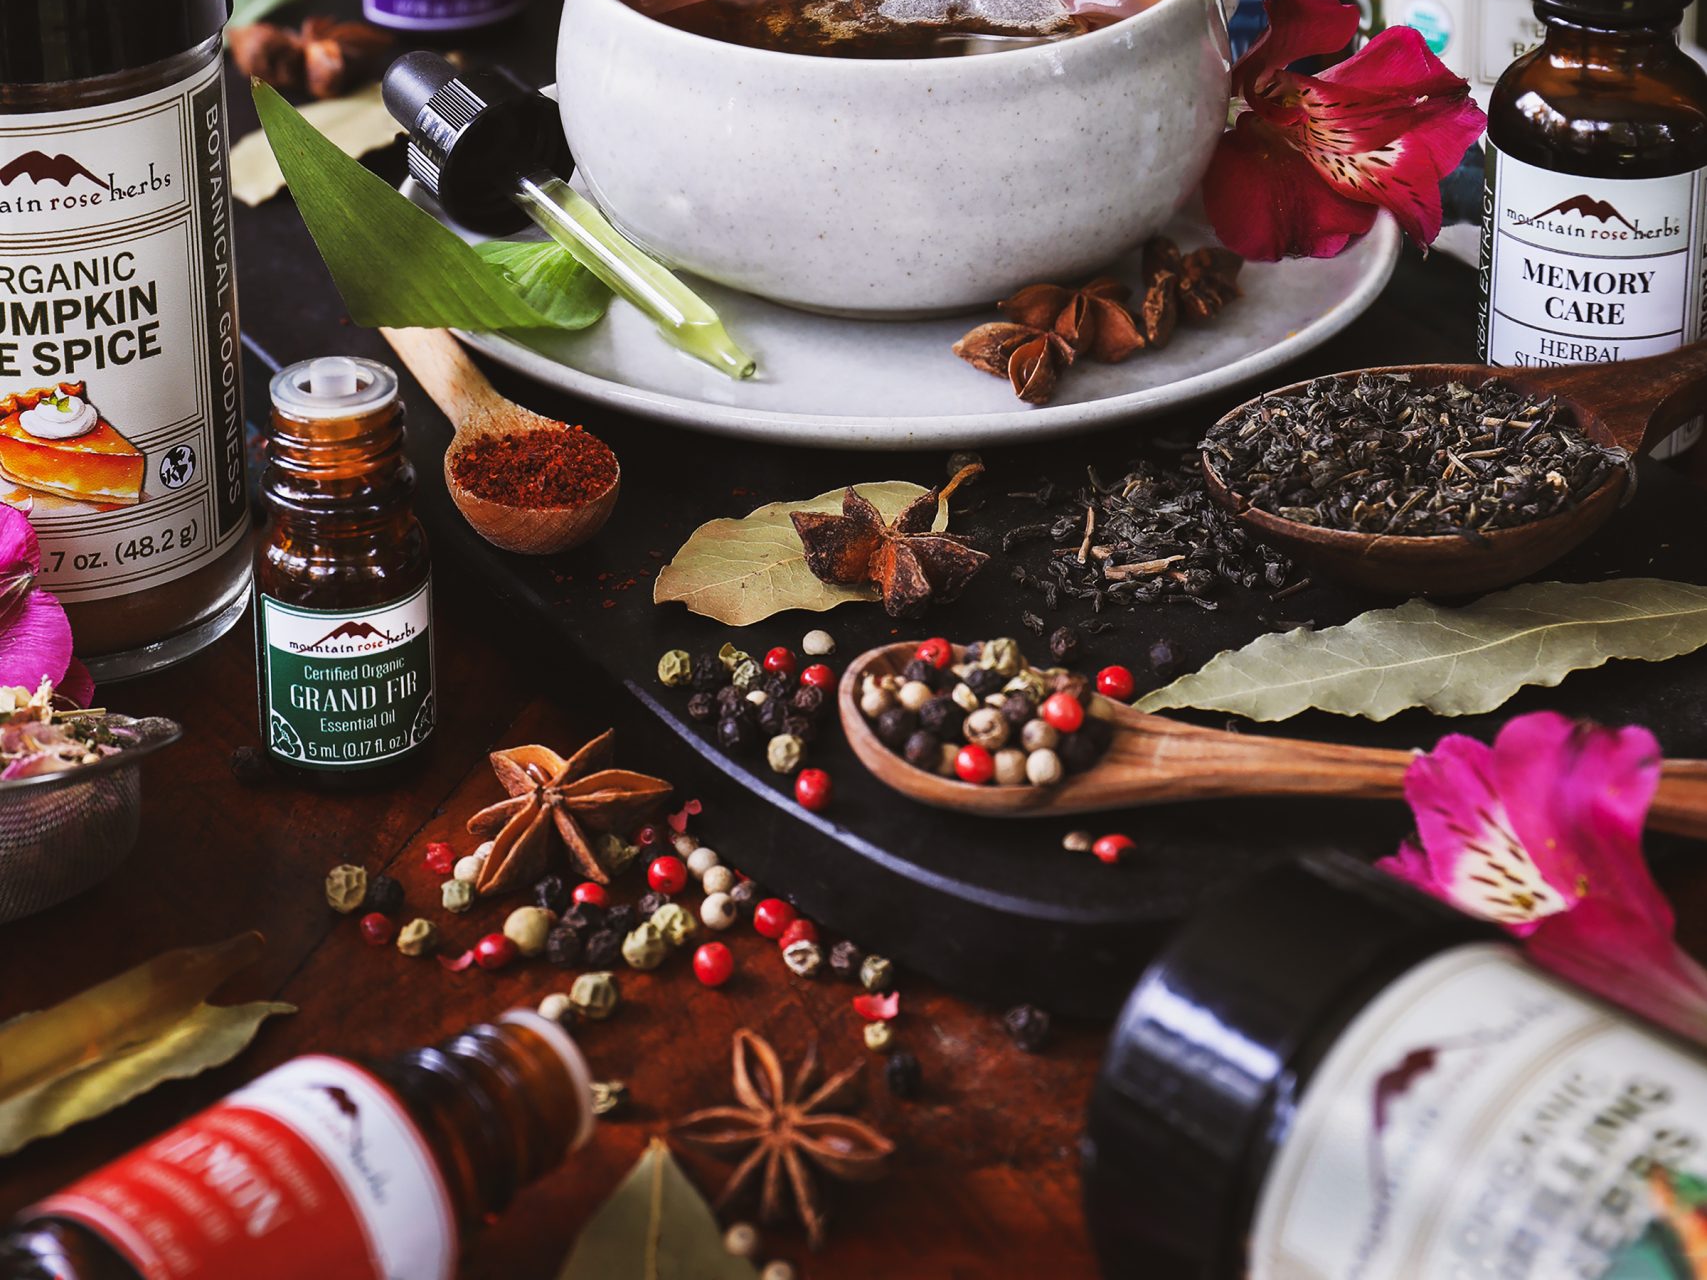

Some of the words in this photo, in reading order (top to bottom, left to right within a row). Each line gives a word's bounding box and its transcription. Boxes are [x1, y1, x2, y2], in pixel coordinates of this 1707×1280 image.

[0, 196, 42, 213] ain
[50, 192, 102, 211] rose
[108, 162, 171, 202] herbs
[1479, 178, 1494, 295] EXTRACT
[1506, 207, 1585, 238] mountain
[1590, 228, 1628, 240] rose
[1633, 216, 1681, 240] herbs
[0, 251, 136, 295] RGANIC
[1522, 257, 1656, 295] MEMORY
[0, 280, 158, 336] MPKIN
[206, 102, 229, 308] BOTANICAL
[219, 312, 241, 506] GOODNESS
[1544, 296, 1625, 325] CARE
[32, 320, 162, 377] SPICE
[1476, 301, 1488, 361] RBAL
[1540, 337, 1620, 363] HERBAL
[43, 551, 66, 572] .7
[73, 552, 108, 570] oz.
[115, 528, 175, 565] (48.2
[180, 519, 198, 548] g)
[289, 641, 354, 654] mountain
[357, 640, 383, 652] rose
[386, 622, 416, 645] herbs
[304, 665, 358, 681] Certified
[362, 657, 405, 679] Organic
[290, 683, 377, 713] GRAND
[386, 670, 418, 704] FIR
[320, 715, 378, 733] Essential
[380, 709, 396, 724] Oil
[308, 742, 317, 757] 5
[320, 743, 340, 758] mL
[343, 738, 371, 760] (0.17
[375, 737, 386, 753] fl.
[389, 730, 408, 749] oz.)
